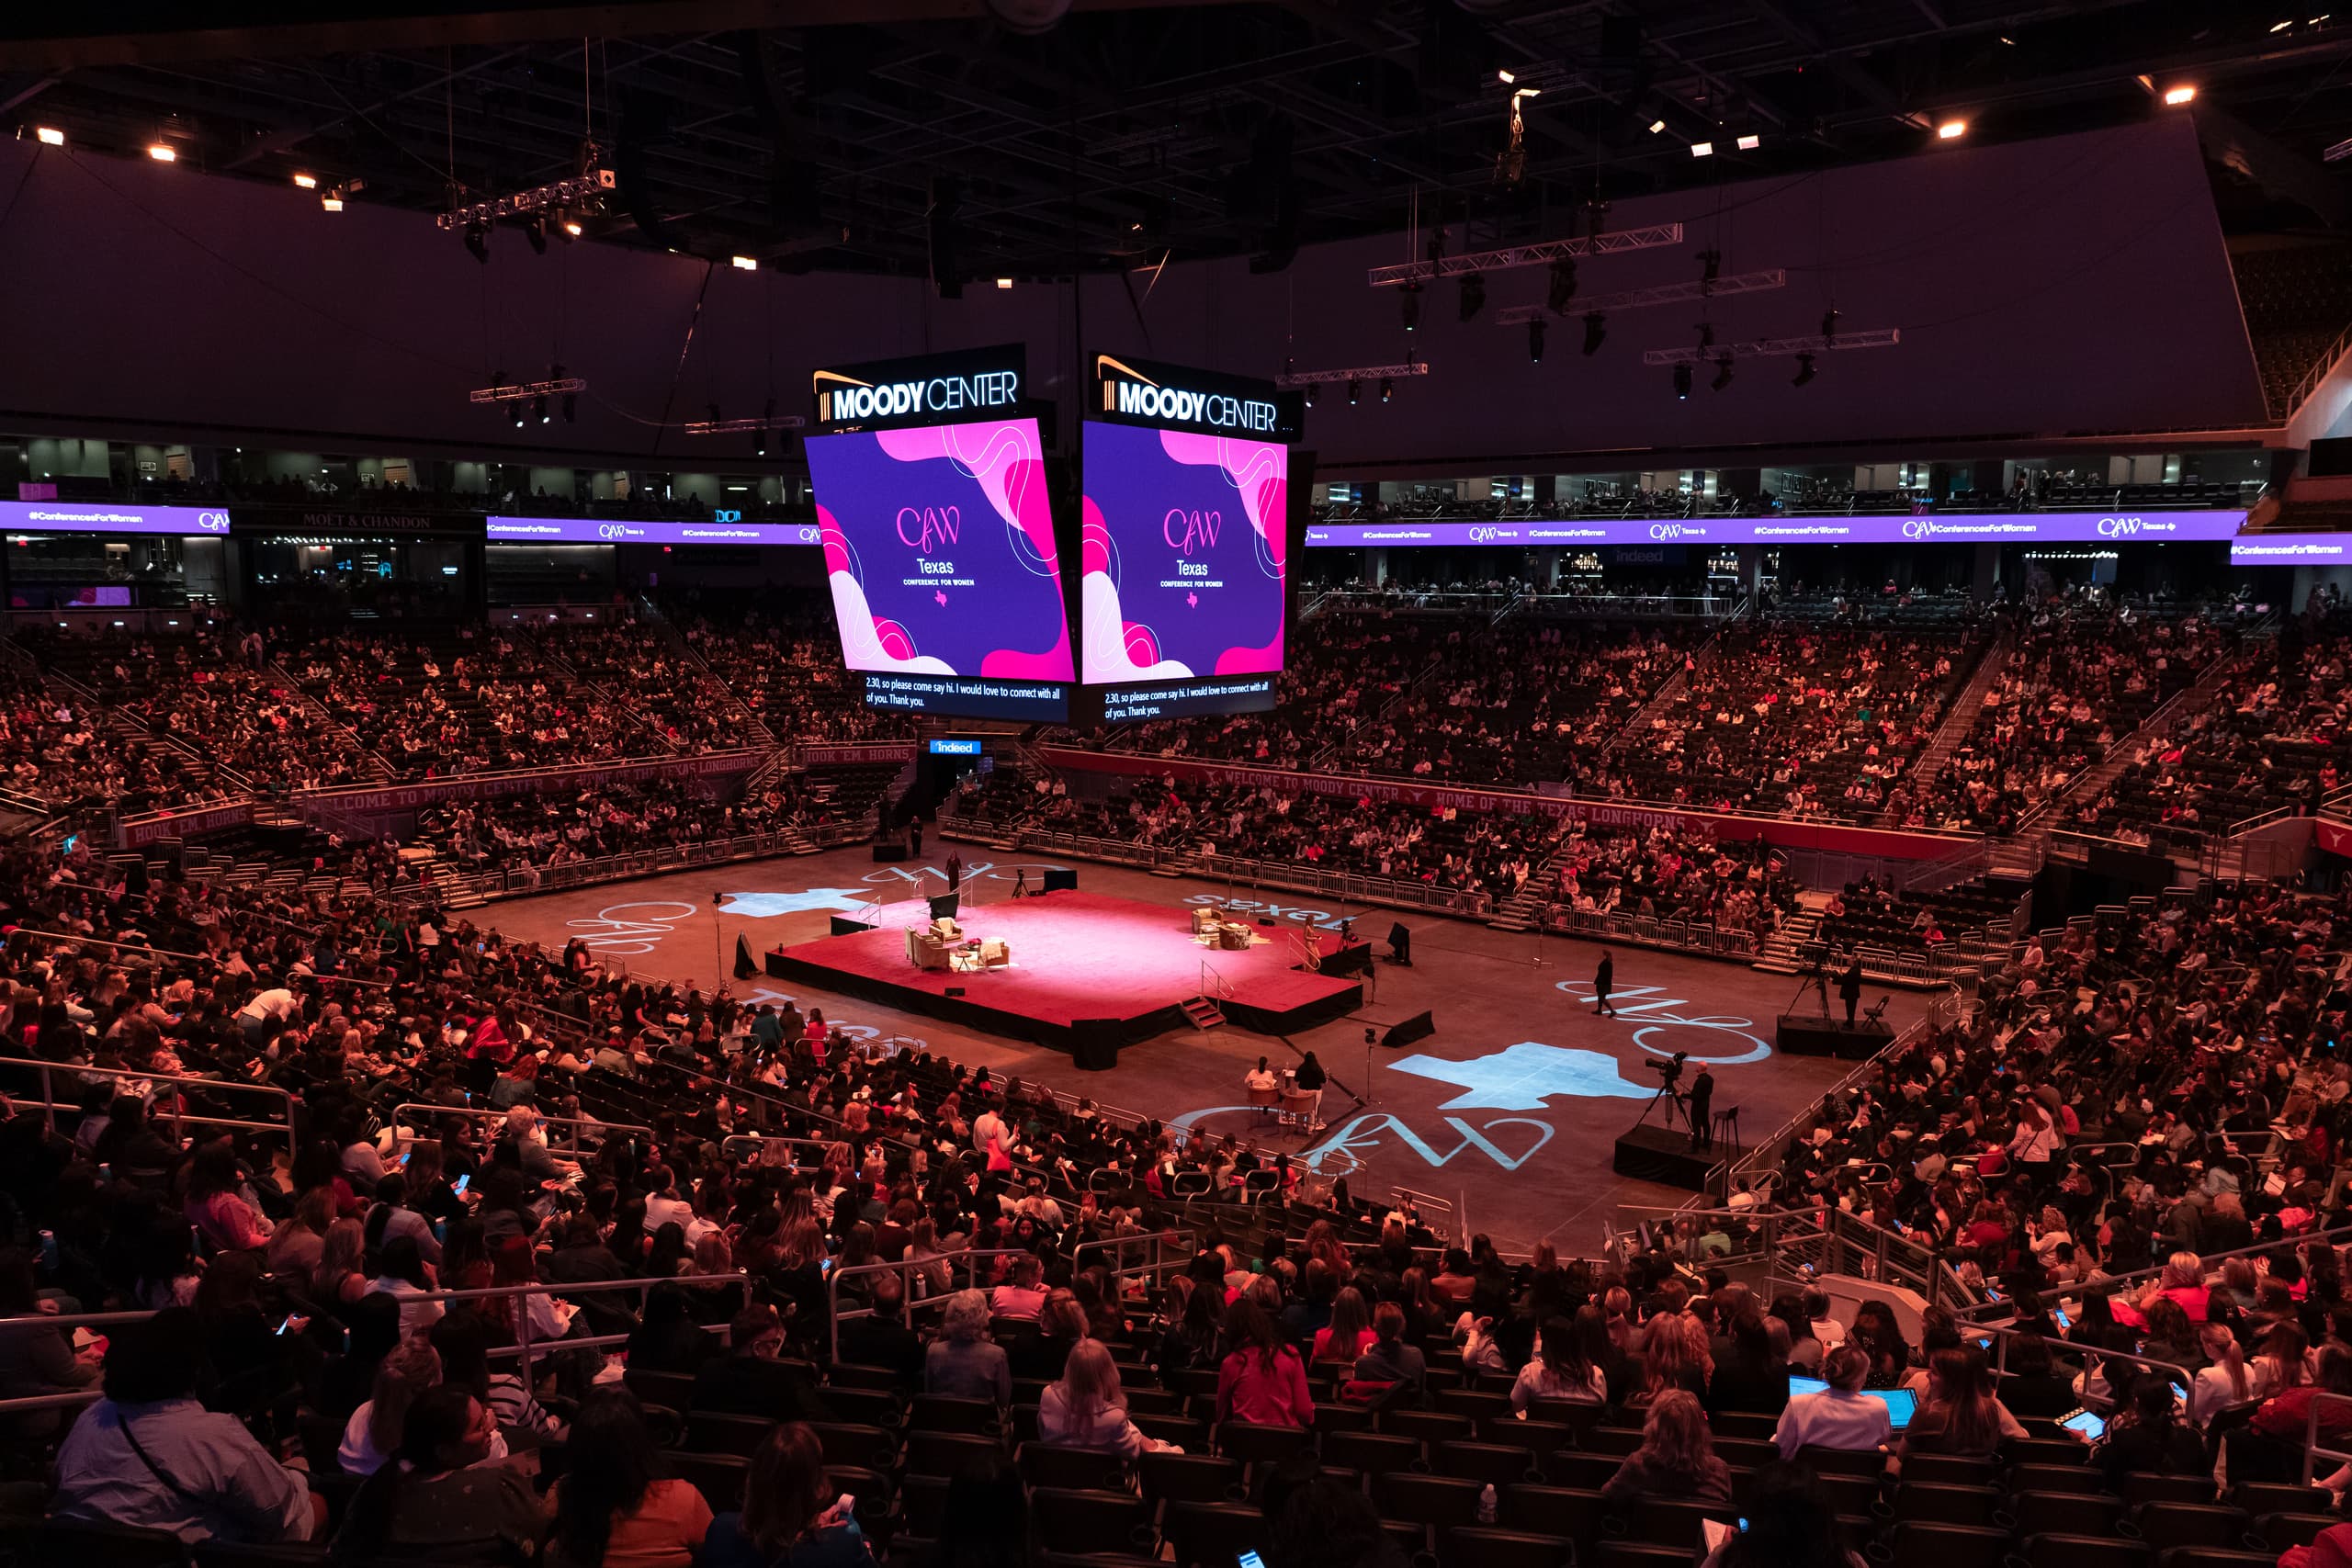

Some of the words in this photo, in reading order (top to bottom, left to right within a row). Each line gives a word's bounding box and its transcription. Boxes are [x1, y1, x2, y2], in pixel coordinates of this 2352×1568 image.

[834, 381, 925, 420] MOODY
[927, 371, 1017, 411] CENTER
[1119, 381, 1206, 423] MOODY
[1206, 394, 1276, 432] CENTER
[349, 514, 358, 527] &
[361, 514, 432, 529] CHANDON
[896, 506, 960, 553] CfW
[1163, 509, 1222, 556] CfW
[2097, 518, 2142, 538] CfW
[2143, 522, 2166, 531] Texas
[916, 558, 955, 574] Texas
[1614, 547, 1665, 563] indeed
[1176, 559, 1208, 576] Texas
[865, 677, 881, 689] 2.30,
[882, 681, 889, 689] so
[891, 680, 912, 692] please
[913, 683, 932, 693] come
[933, 684, 945, 695] say
[946, 682, 956, 694] hi.
[960, 683, 982, 695] would
[983, 684, 1000, 696] love
[1001, 687, 1009, 696] to
[1010, 688, 1036, 698] connect
[1037, 688, 1052, 699] with
[1052, 689, 1060, 700] all
[866, 692, 875, 703] of
[874, 694, 888, 705] you.
[889, 694, 910, 706] Thank
[910, 697, 925, 708] you.
[1105, 694, 1120, 705] 2.30,
[1121, 694, 1129, 704] so
[1130, 691, 1149, 704] please
[1150, 692, 1167, 701] come
[1168, 691, 1178, 702] say
[1190, 686, 1208, 697] would
[1208, 685, 1220, 696] love
[1221, 686, 1227, 694] to
[1227, 684, 1250, 694] connect
[1250, 682, 1261, 693] with
[1105, 709, 1114, 719] of
[1113, 709, 1126, 721] you.
[1127, 706, 1147, 717] Thank
[1147, 706, 1160, 718] you.
[937, 741, 973, 753] indeed
[660, 763, 696, 778] TEXAS
[698, 755, 762, 774] LONGHORNS
[397, 790, 418, 805] TO
[483, 777, 544, 796] CENTER
[1225, 770, 1280, 790] WELCOME
[1283, 776, 1299, 789] TO
[1303, 777, 1345, 795] MOODY
[1349, 782, 1399, 800] CENTER
[1436, 792, 1476, 809] HOME
[1478, 796, 1498, 810] OF
[1503, 798, 1532, 815] THE
[1536, 801, 1587, 820] TEXAS
[1591, 807, 1687, 831] LONGHORNS
[134, 823, 172, 843] HOOK
